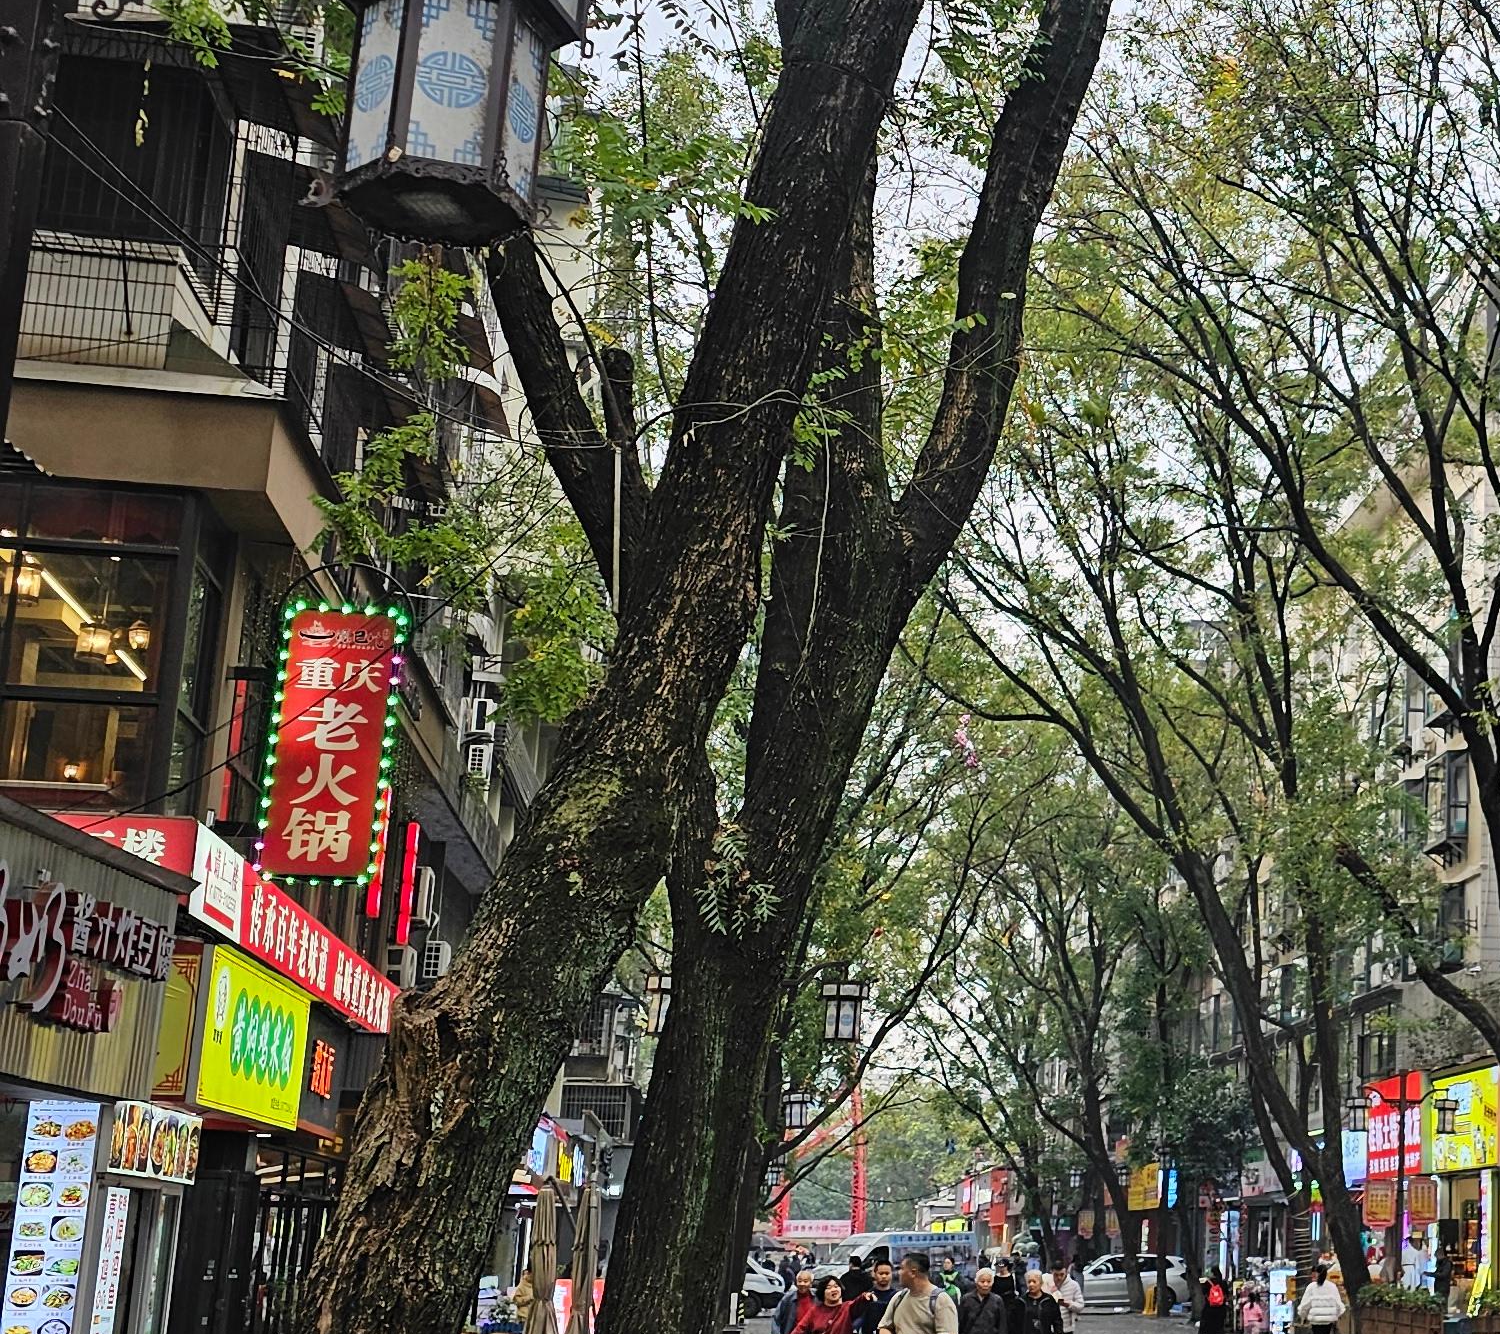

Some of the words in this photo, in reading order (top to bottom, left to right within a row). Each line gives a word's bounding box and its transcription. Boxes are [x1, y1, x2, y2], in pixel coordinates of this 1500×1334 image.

[294, 656, 385, 693] 重庆
[281, 697, 369, 863] 老火锅
[71, 892, 177, 981] 酱汁炸豆腐
[249, 884, 330, 992] 传承百年老味道
[232, 997, 294, 1079] 黄焖鸡米饭
